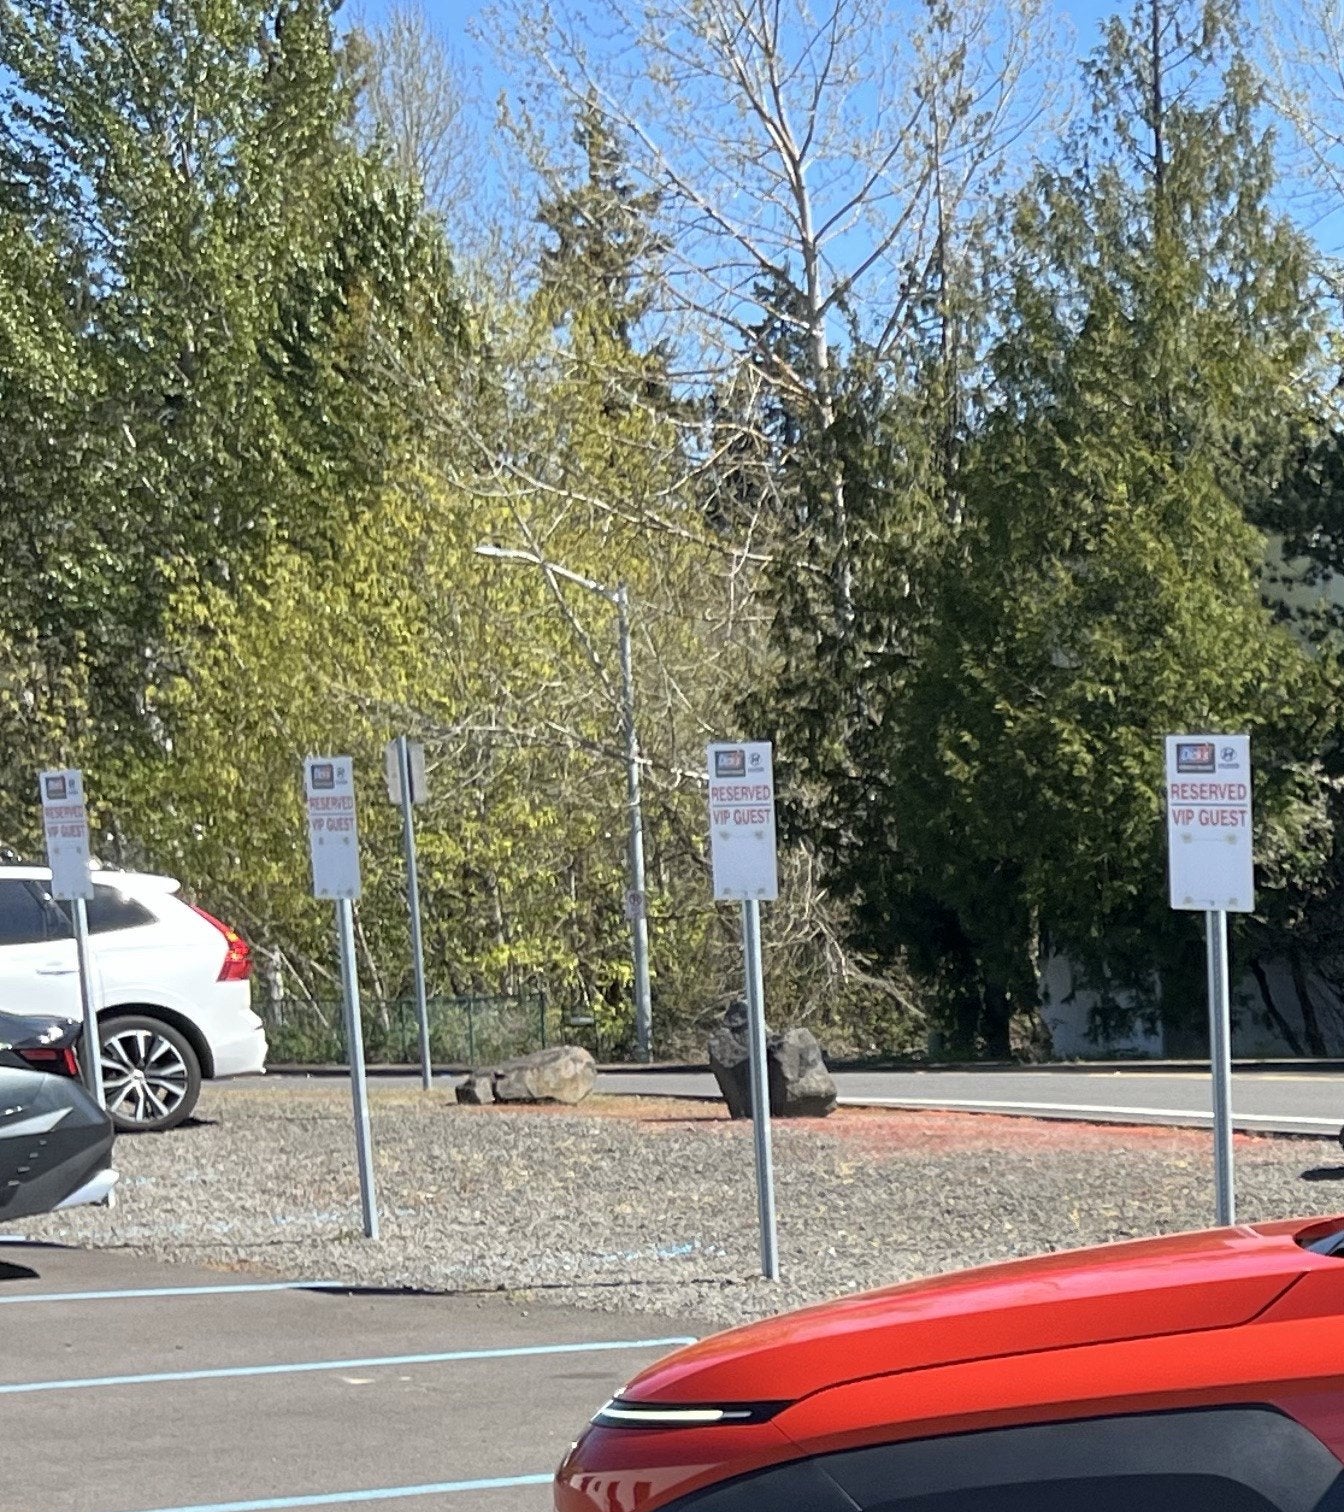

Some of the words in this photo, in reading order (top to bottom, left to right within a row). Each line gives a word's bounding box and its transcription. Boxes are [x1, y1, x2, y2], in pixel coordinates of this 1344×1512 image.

[711, 785, 772, 802] RESERVED
[1171, 783, 1248, 801] RESERVED
[713, 809, 731, 825] VIP
[733, 809, 772, 825] GUEST
[1171, 809, 1195, 827] VIP
[1199, 809, 1248, 827] GUEST
